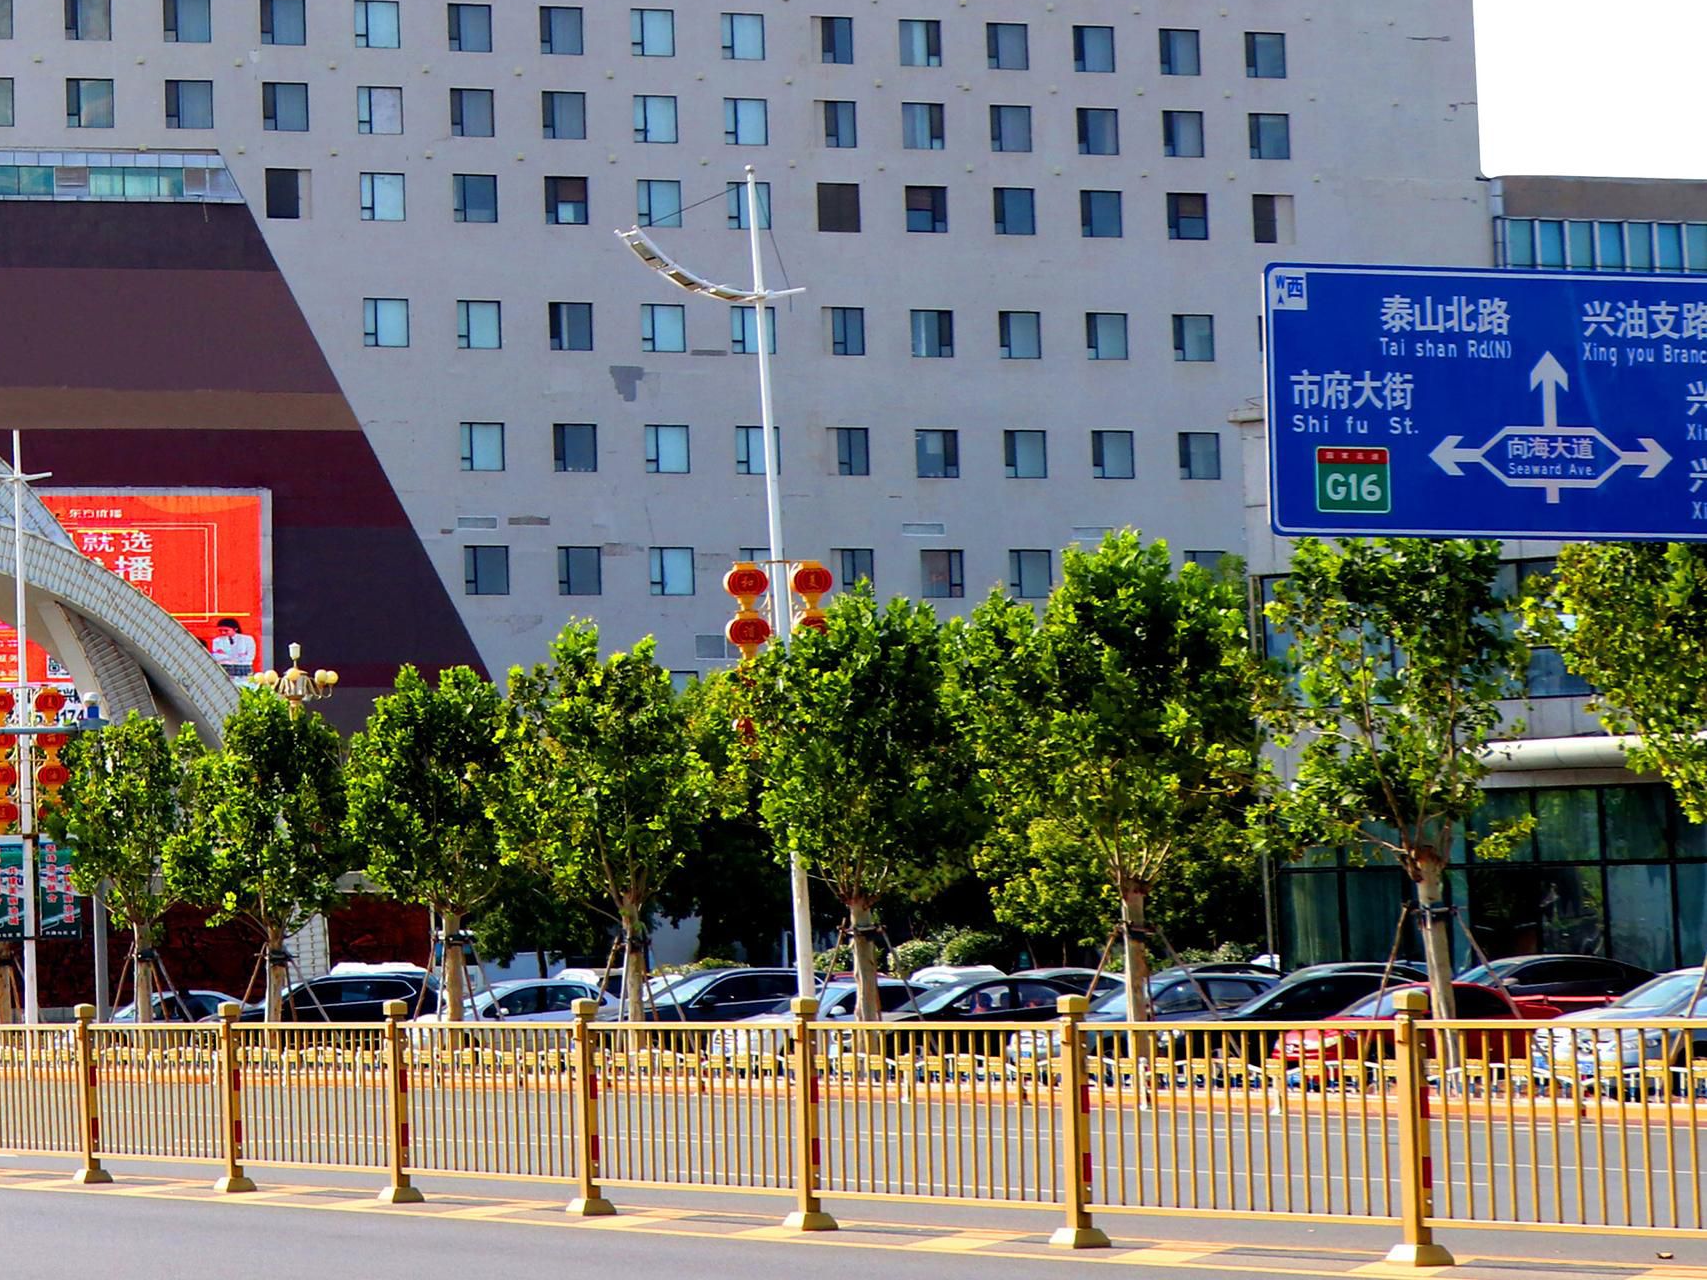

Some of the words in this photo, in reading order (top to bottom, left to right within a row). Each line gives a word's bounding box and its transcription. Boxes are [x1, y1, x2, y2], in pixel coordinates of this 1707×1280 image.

[1285, 276, 1304, 298] 西
[1379, 294, 1511, 336] 泰山北路
[1582, 299, 1707, 341] 兴油支路
[1379, 337, 1406, 356] Tai
[1415, 339, 1458, 358] shan
[1582, 342, 1618, 367] Xing
[1626, 347, 1655, 366] you
[1289, 369, 1415, 411] 市府大街
[1292, 414, 1330, 433] Shi
[1345, 416, 1369, 434] fu
[1389, 416, 1420, 435] St.
[1507, 436, 1595, 460] 向海大道
[1508, 462, 1562, 476] Seaward
[1569, 463, 1596, 476] Ave.
[1325, 472, 1382, 502] G16
[68, 531, 154, 554] 就选
